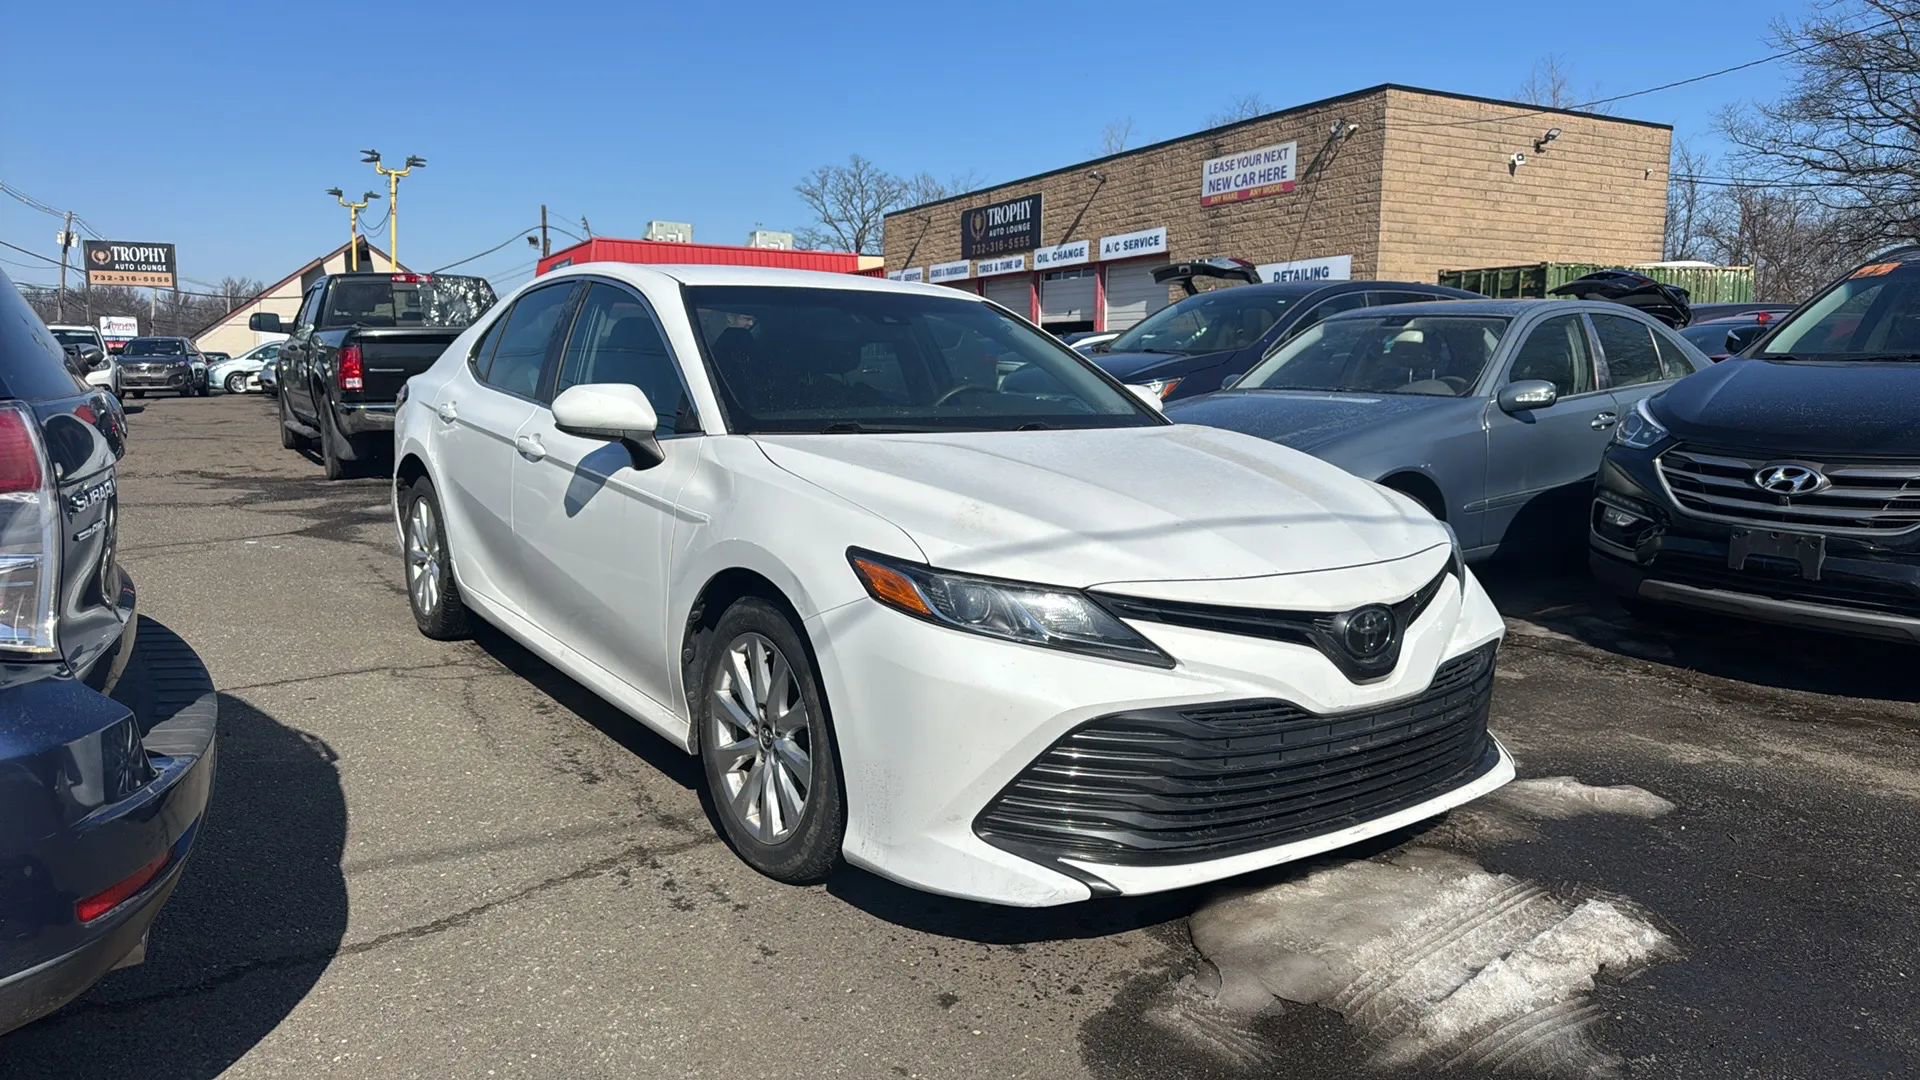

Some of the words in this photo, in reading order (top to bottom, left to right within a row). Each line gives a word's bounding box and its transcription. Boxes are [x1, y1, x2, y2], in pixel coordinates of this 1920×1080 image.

[1208, 159, 1235, 175] LEASE
[1237, 153, 1262, 169] YOUR
[1264, 147, 1290, 163] NEXT
[1208, 175, 1233, 193] NEW
[1234, 171, 1256, 188] CAR
[1258, 165, 1288, 183] HERE
[987, 199, 1033, 226] TROPHY
[989, 227, 1005, 237] AUTO
[1006, 222, 1031, 234] LOUNGE
[972, 235, 1031, 255] 732-316-5555
[1105, 241, 1120, 254] A/C
[1123, 235, 1160, 251] SERVICE
[110, 246, 167, 263] TROPHY
[1037, 253, 1049, 264] OIL
[1052, 247, 1085, 261] CHANGE
[114, 263, 135, 271] AUTO
[138, 264, 167, 272] LOUNGE
[979, 263, 993, 273] TIRES
[1000, 260, 1013, 270] TUNE
[1014, 258, 1023, 268] UP
[93, 274, 170, 283] 732-316-5555
[1273, 266, 1330, 283] DETAILING
